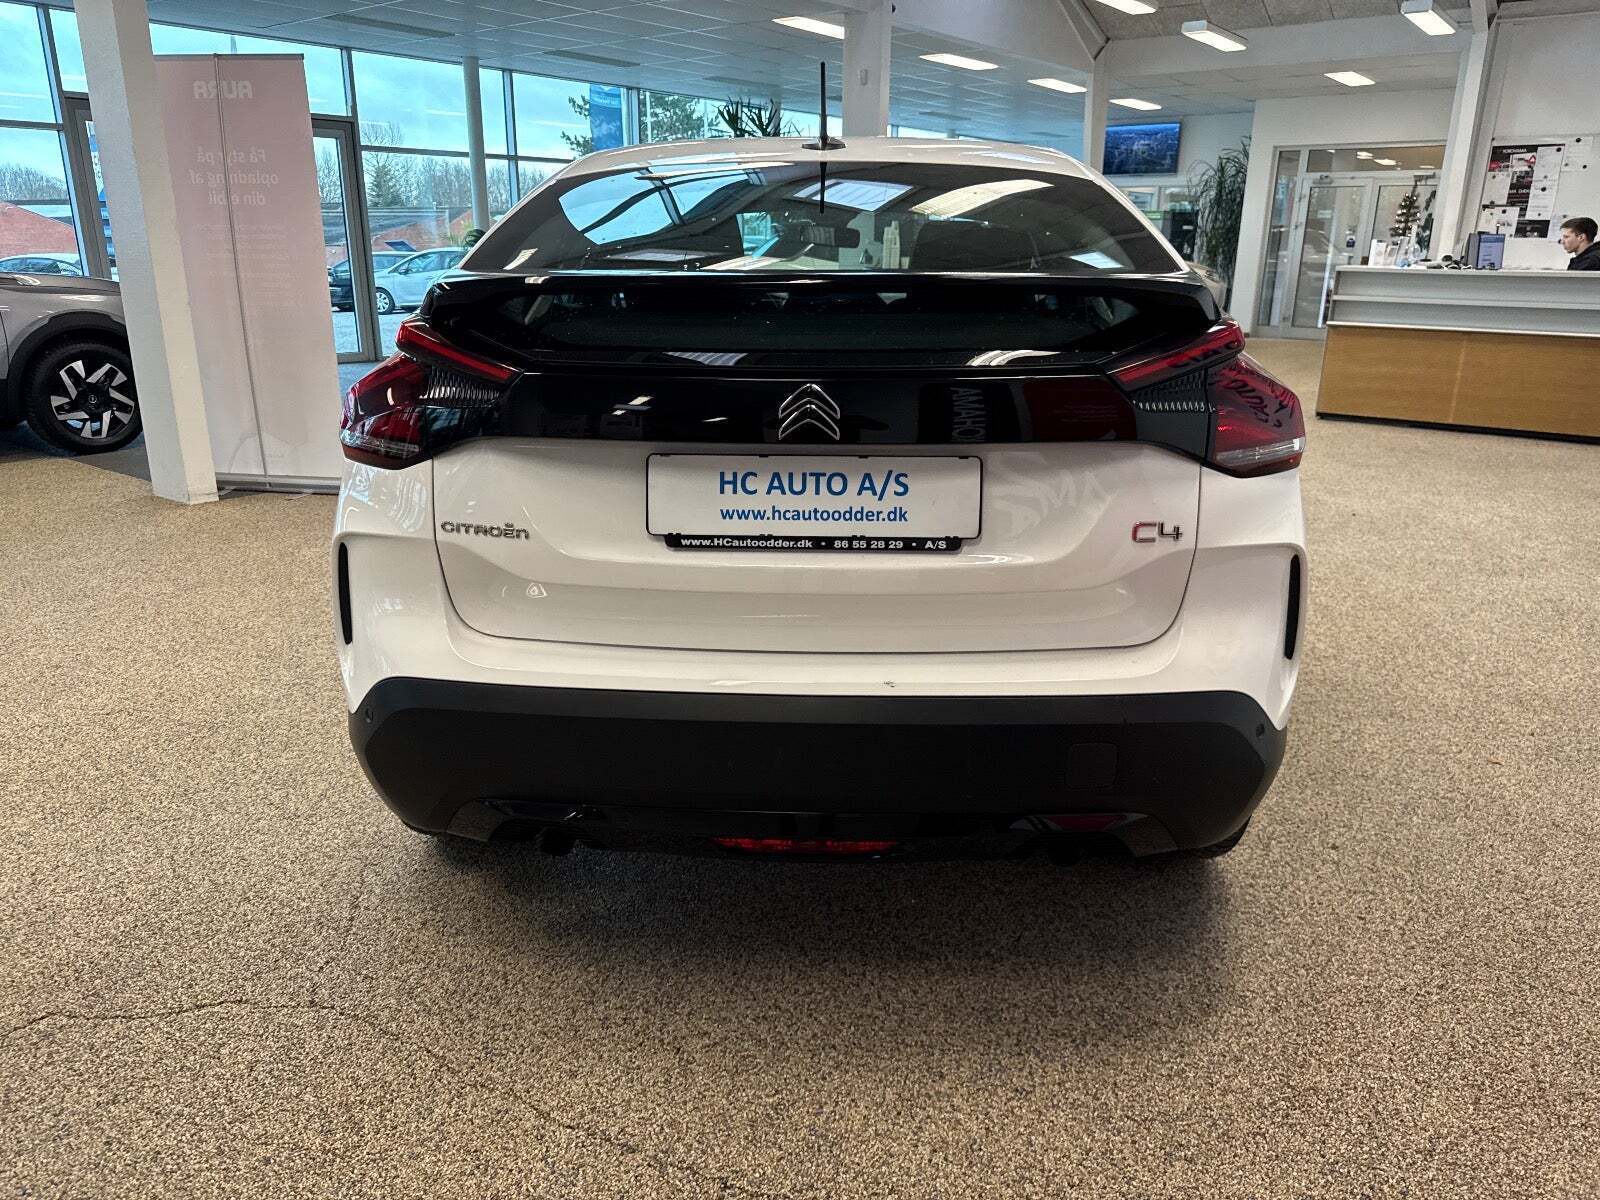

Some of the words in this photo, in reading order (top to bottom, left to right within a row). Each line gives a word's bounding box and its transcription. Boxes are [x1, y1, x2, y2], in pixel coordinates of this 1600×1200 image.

[719, 471, 757, 496] HC
[766, 471, 848, 496] AUTO
[857, 470, 909, 502] A/S
[720, 506, 908, 523] www.hcautoodder.dk
[1132, 521, 1183, 543] C4
[681, 537, 813, 549] www.HCautoodder.dk
[834, 539, 849, 549] 86
[852, 539, 867, 549] 55
[870, 540, 886, 549] 28
[889, 540, 904, 549] 29
[924, 540, 947, 550] A/S
